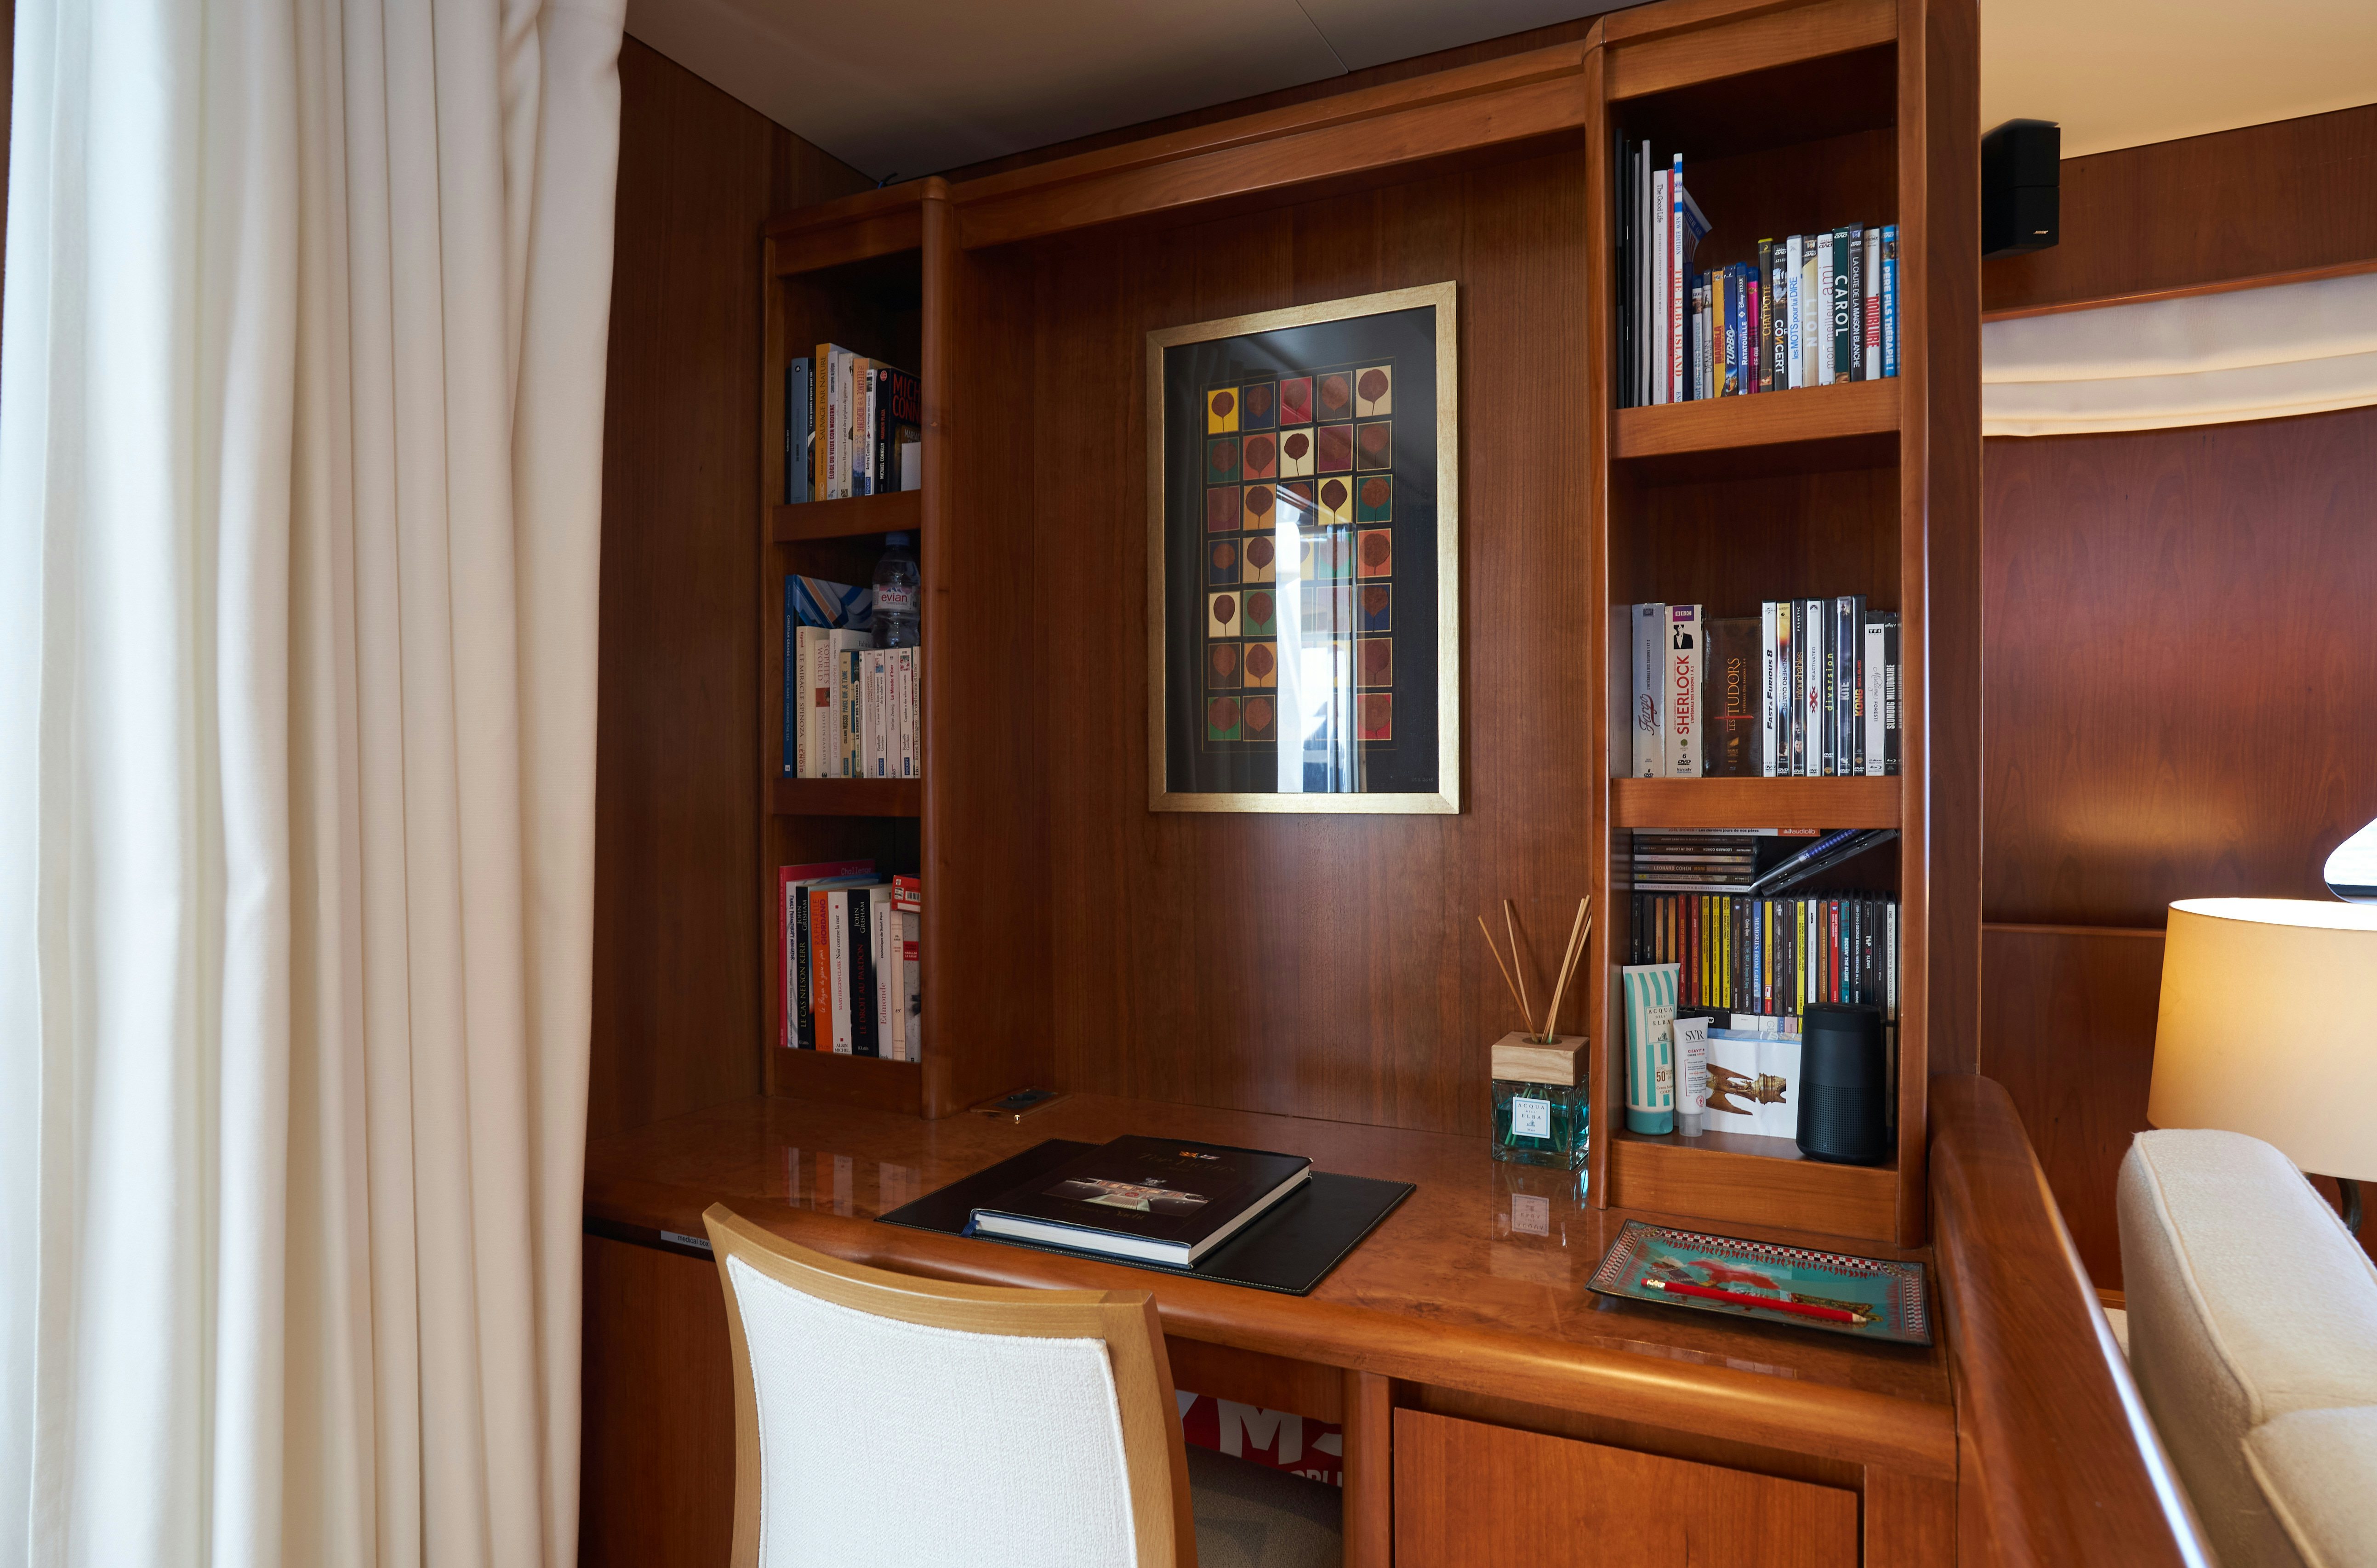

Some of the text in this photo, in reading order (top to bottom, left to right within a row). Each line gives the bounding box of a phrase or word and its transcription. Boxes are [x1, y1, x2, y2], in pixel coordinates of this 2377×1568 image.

[1790, 277, 1798, 297] DIRE
[1853, 288, 1859, 298] DE
[1791, 307, 1800, 323] pour
[1819, 265, 1834, 369] mon meilleur ami
[1835, 275, 1848, 336] CAROL
[1882, 266, 1894, 365] PÈRE FILS THÉRAPIE
[1805, 299, 1818, 347] LION
[1865, 296, 1880, 348] DOUBLURE
[1726, 324, 1735, 366] TURBO
[1774, 319, 1784, 374] CONCERT
[881, 593, 908, 602] evian
[800, 654, 805, 662] LE
[1767, 649, 1773, 658] 8
[1676, 654, 1690, 735] SHERLOCK
[1727, 658, 1741, 716] TUDORS
[1825, 653, 1833, 711] diversion
[1840, 682, 1849, 700] KITE
[1868, 666, 1883, 699] Madame
[1855, 689, 1864, 716] KONG
[1886, 664, 1895, 730] SLUMDOG MILLIONAIRE
[1638, 693, 1660, 736] Fargo
[858, 982, 865, 994] AU
[858, 994, 866, 1023] DROIT
[800, 1019, 806, 1028] LE
[860, 1025, 866, 1035] LE
[1685, 1029, 1704, 1042] SVR
[1656, 1071, 1665, 1082] 50
[678, 1235, 698, 1244] medical
